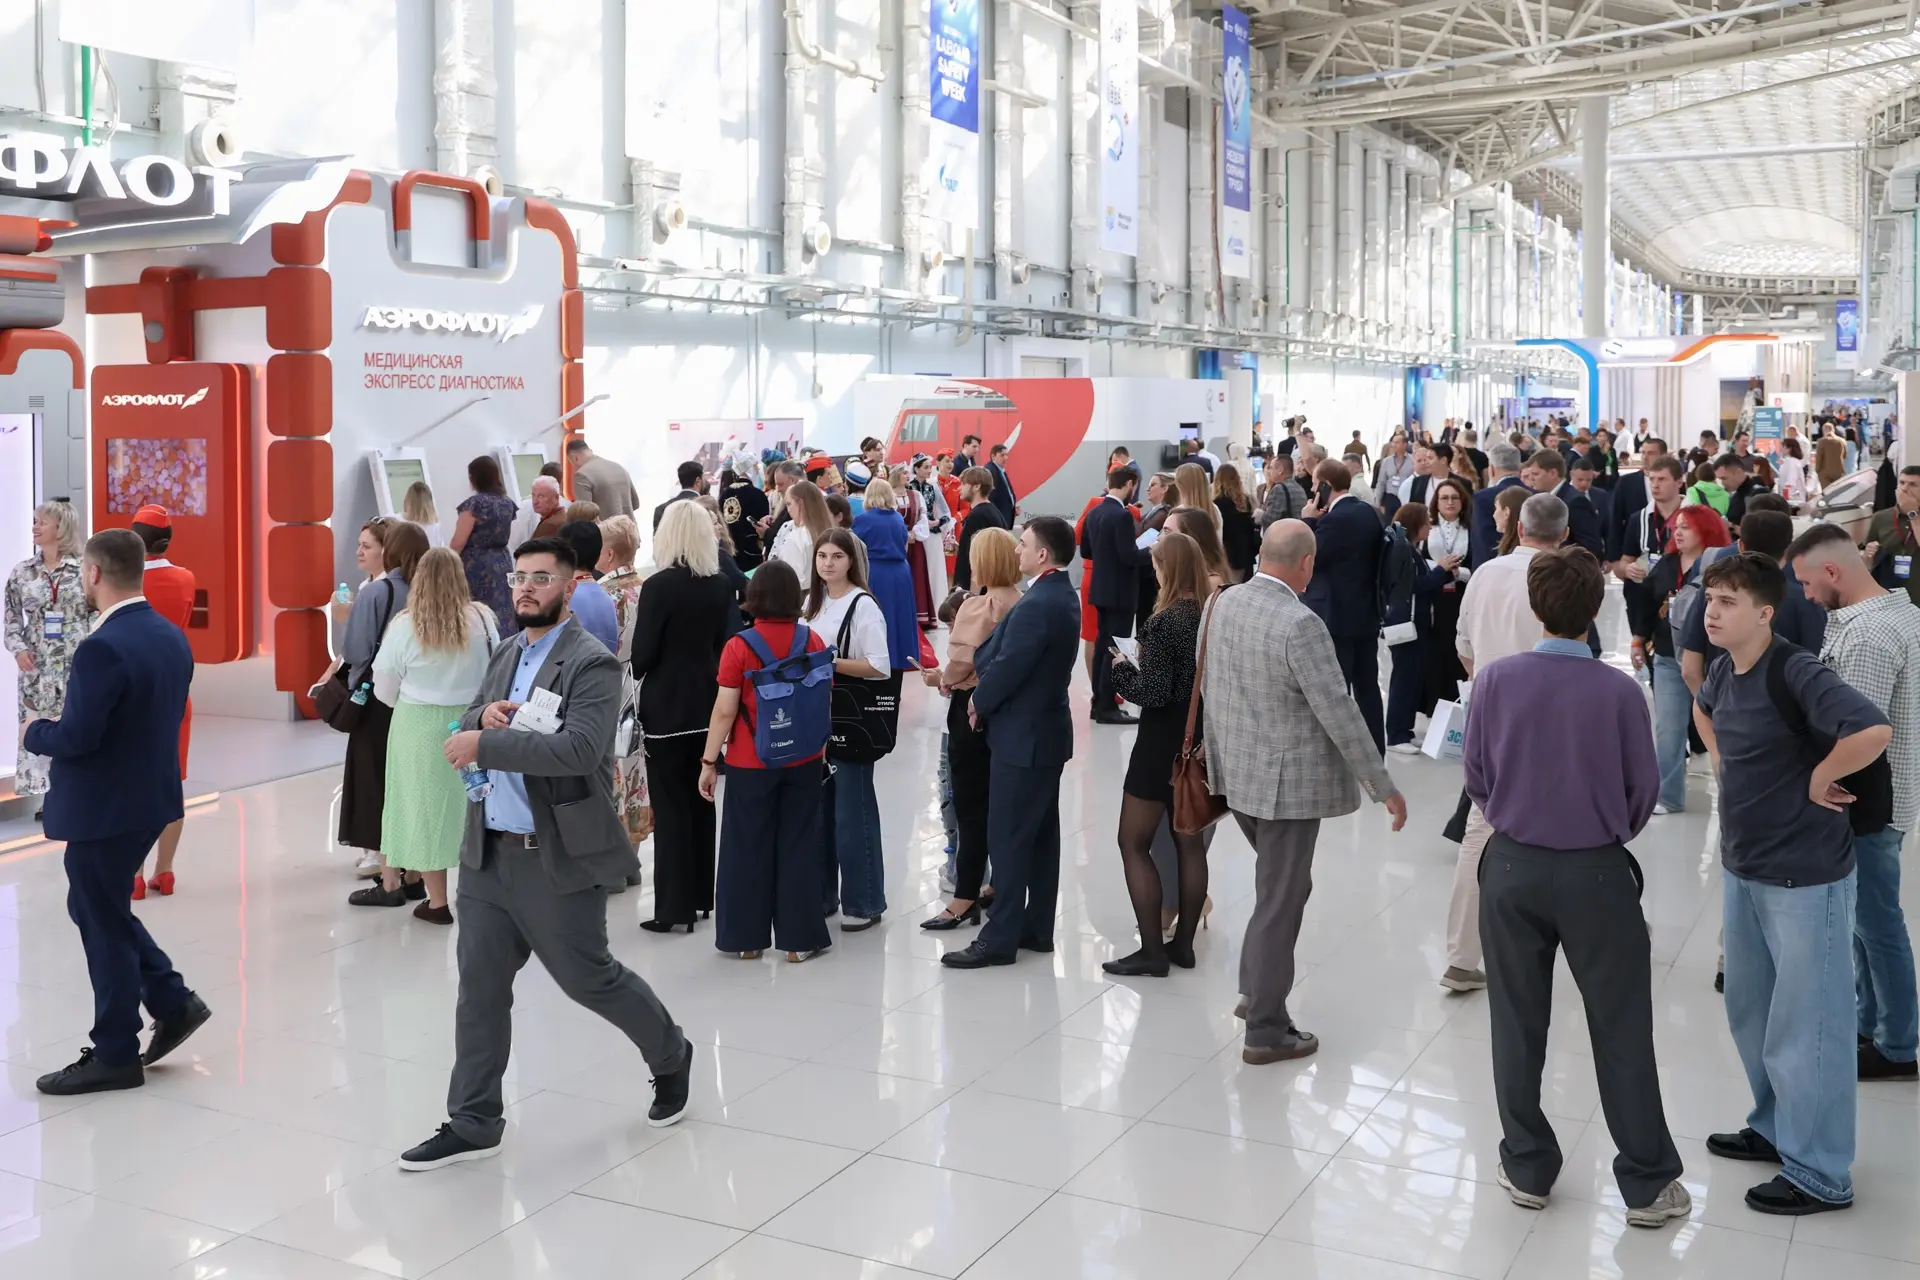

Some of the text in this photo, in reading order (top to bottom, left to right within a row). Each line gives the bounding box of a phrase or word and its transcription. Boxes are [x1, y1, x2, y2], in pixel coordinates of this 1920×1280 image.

[941, 77, 966, 102] WEEK
[363, 306, 510, 333] АЭРОФЛОТ
[364, 352, 463, 371] МЕДИЦИНСКАЯ
[364, 373, 525, 391] ЭКСПРЕСС ДИАГНОСТИКА
[101, 394, 186, 406] АЭРОФЛОТ
